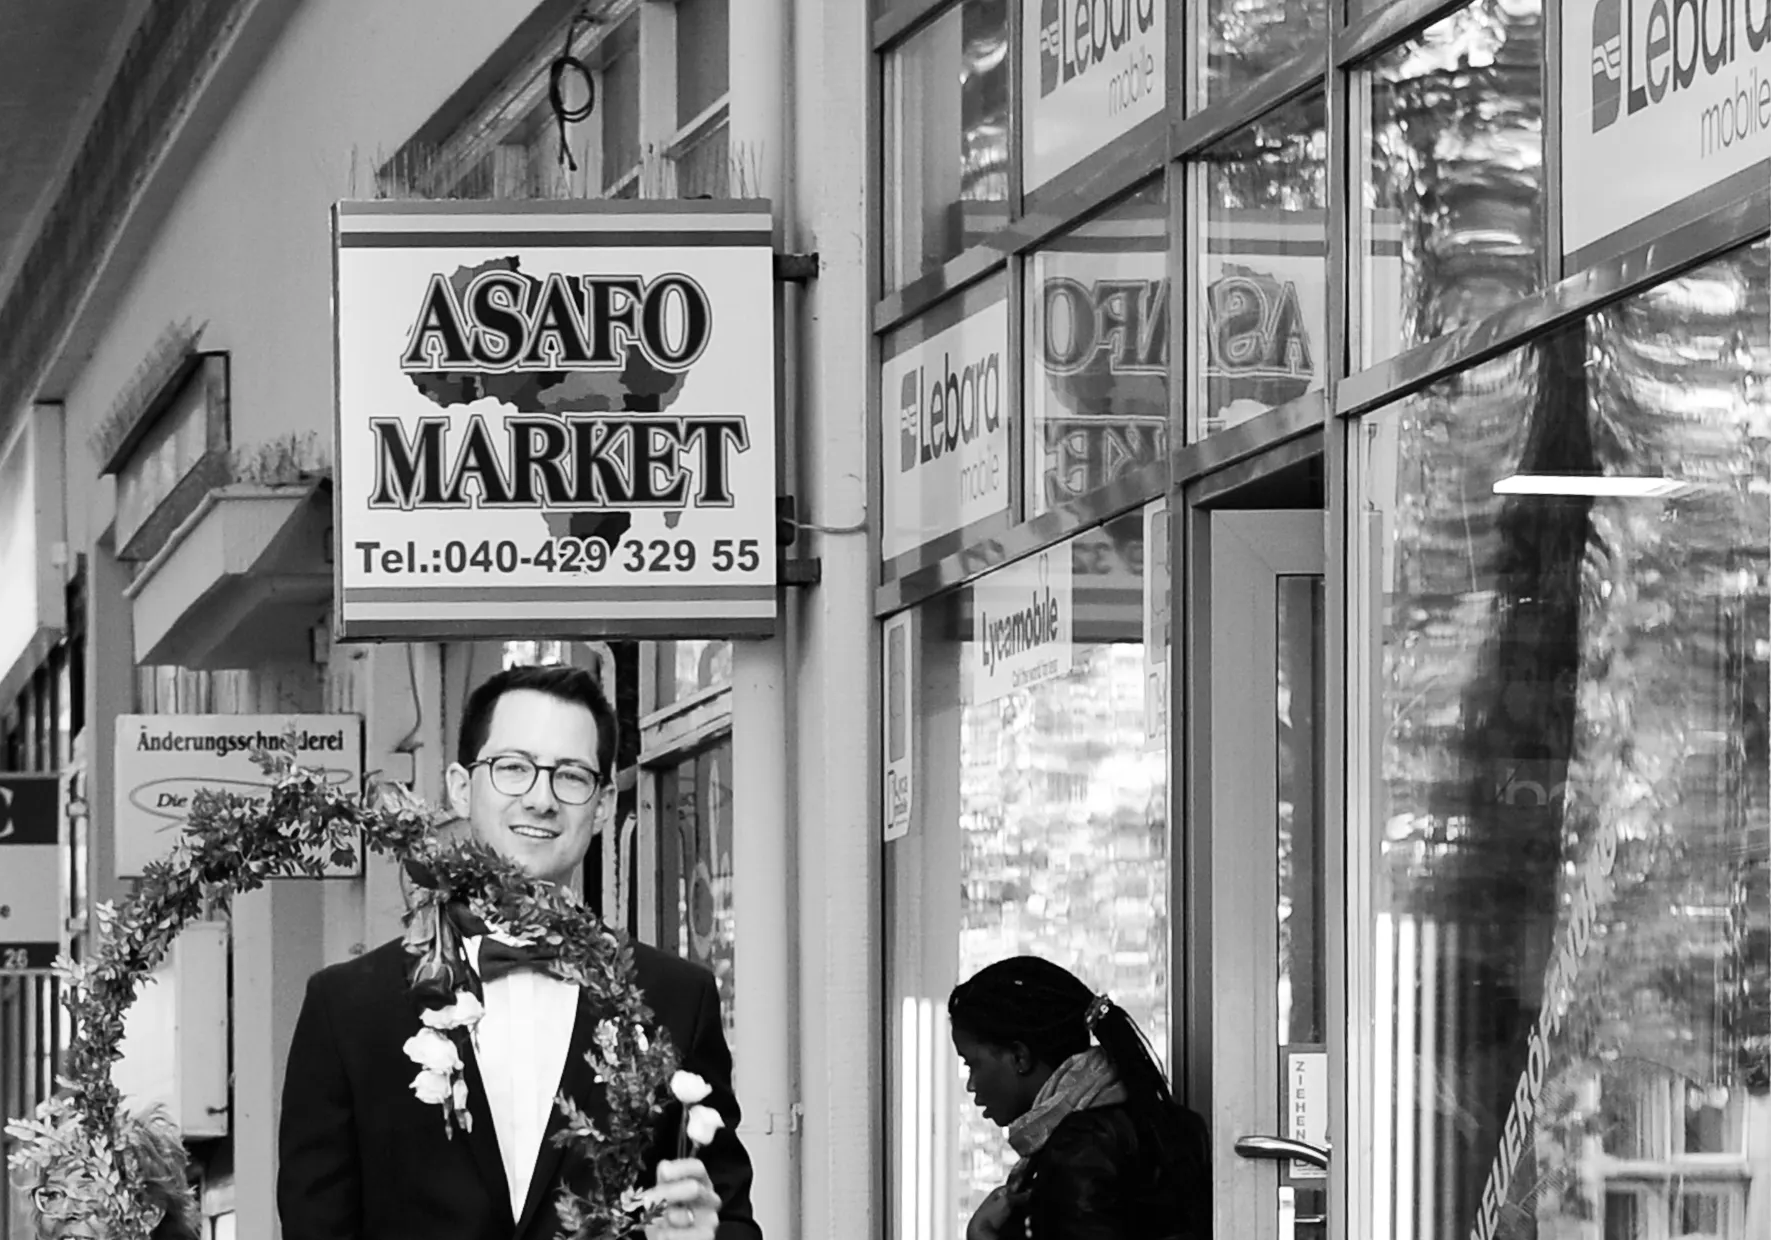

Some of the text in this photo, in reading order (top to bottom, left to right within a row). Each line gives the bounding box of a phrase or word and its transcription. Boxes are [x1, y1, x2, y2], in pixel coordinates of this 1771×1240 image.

[1700, 66, 1771, 159] mobile
[400, 273, 712, 372] ASAFO
[920, 352, 999, 465] Lebara
[368, 415, 750, 511] MARKET
[355, 540, 760, 574] Tel.:040-429 329 55
[982, 585, 1058, 677] Lycamobile
[137, 726, 344, 757] Änderungsschnderei
[156, 792, 188, 808] Die
[1295, 1060, 1307, 1141] ZIEHEN
